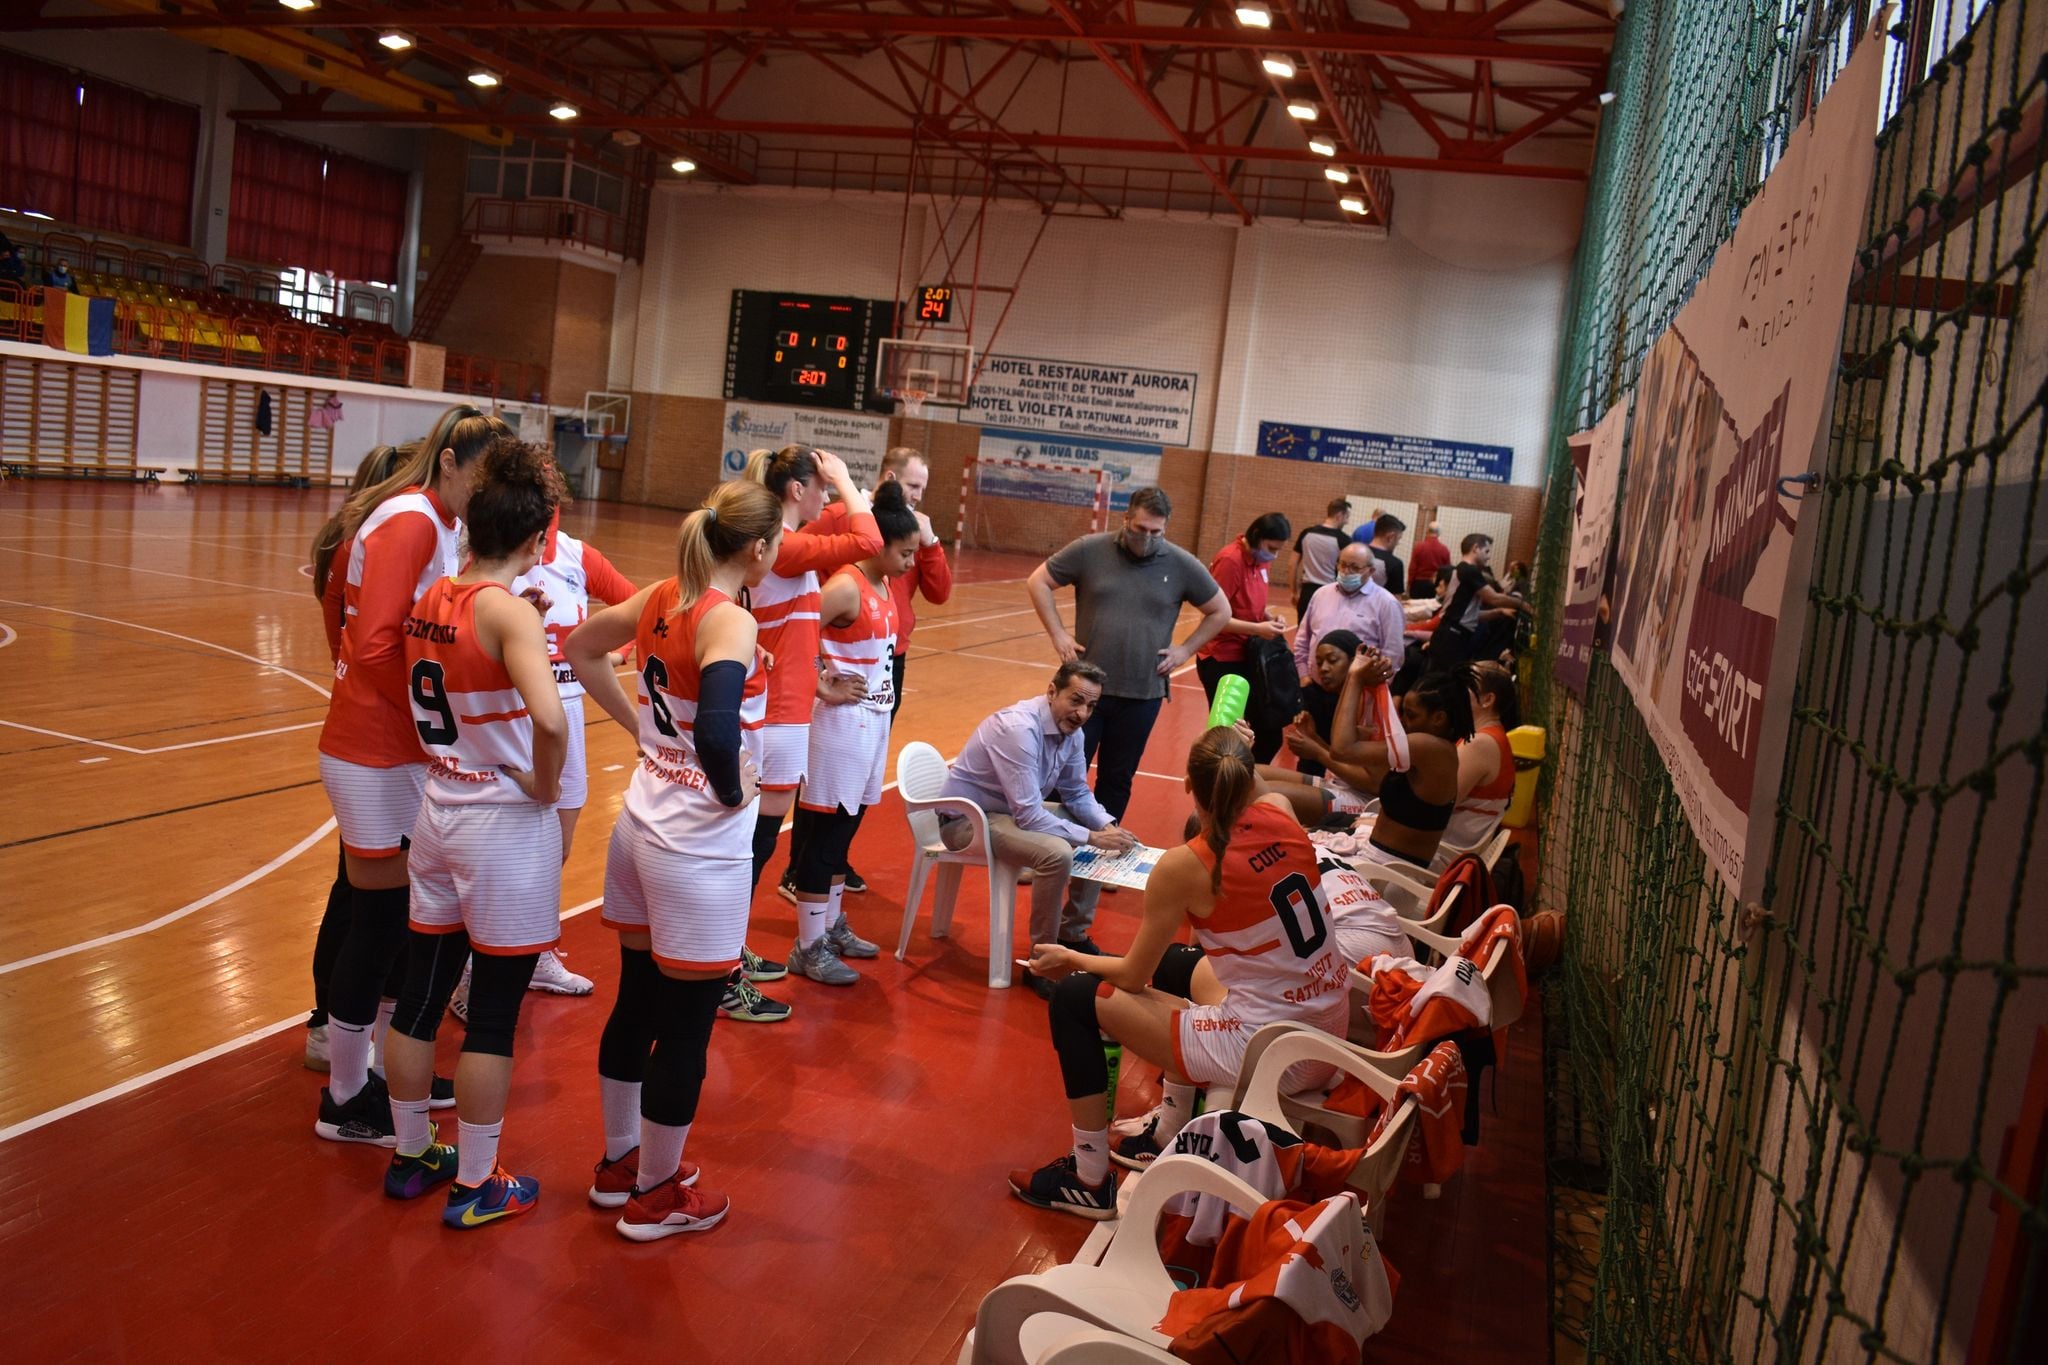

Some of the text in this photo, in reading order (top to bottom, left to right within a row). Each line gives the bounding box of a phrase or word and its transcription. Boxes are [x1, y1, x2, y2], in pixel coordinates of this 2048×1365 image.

[922, 300, 944, 318] 24
[789, 332, 798, 347] 0
[811, 336, 817, 346] 1
[836, 336, 846, 350] 0
[775, 350, 783, 362] 0
[838, 356, 846, 368] 0
[799, 370, 826, 385] 2:07
[991, 360, 1189, 391] HOTEL RESTAURANT AURORA
[1072, 383, 1087, 393] DE
[1090, 385, 1135, 398] TURISM
[972, 396, 1014, 412] HOTEL
[1018, 401, 1073, 418] VIOLETA
[1135, 416, 1178, 429] JUPITER
[818, 416, 848, 428] despre
[852, 419, 883, 430] sportul
[1040, 444, 1072, 458] NOVA
[411, 658, 459, 746] 9
[643, 654, 678, 738] 6
[1248, 842, 1288, 873] CUIC
[1269, 872, 1328, 960] 0
[1284, 979, 1321, 1004] SATU
